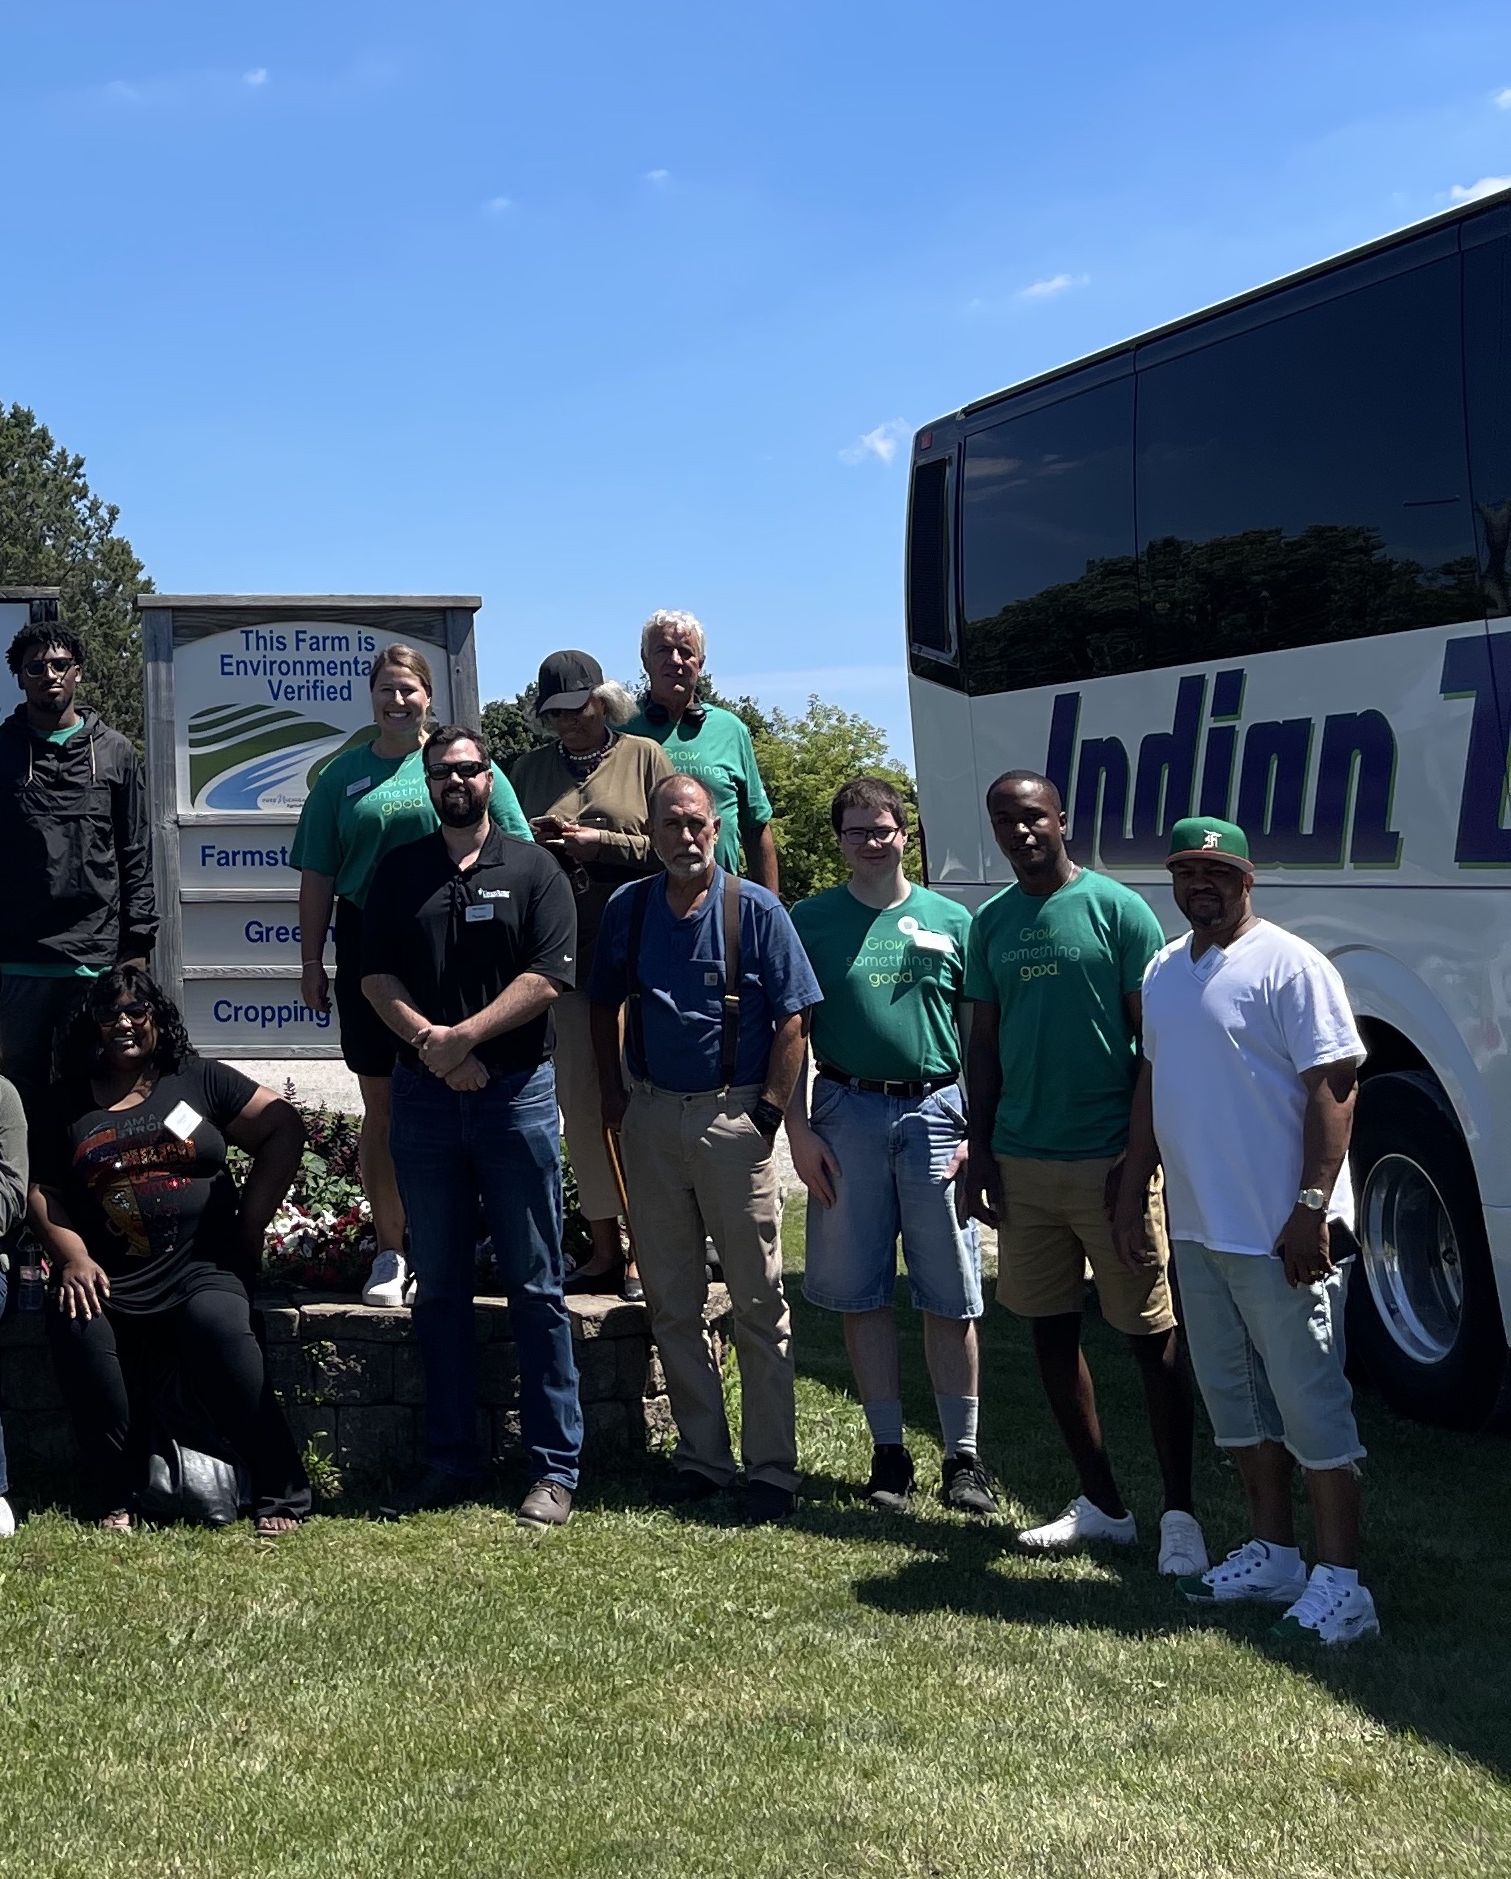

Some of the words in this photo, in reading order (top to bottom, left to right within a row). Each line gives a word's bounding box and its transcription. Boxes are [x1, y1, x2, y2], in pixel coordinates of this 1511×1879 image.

[240, 630, 287, 651] This
[295, 630, 350, 652] Farm
[357, 631, 376, 652] is
[220, 654, 376, 676] Environmenta
[267, 679, 352, 701] Verified
[1046, 668, 1404, 870] Indian
[201, 845, 289, 867] Farmst
[865, 936, 906, 951] Grow
[1020, 927, 1059, 942] Grow
[846, 953, 933, 971] something
[1001, 942, 1081, 963] something
[213, 1000, 331, 1028] Cropping
